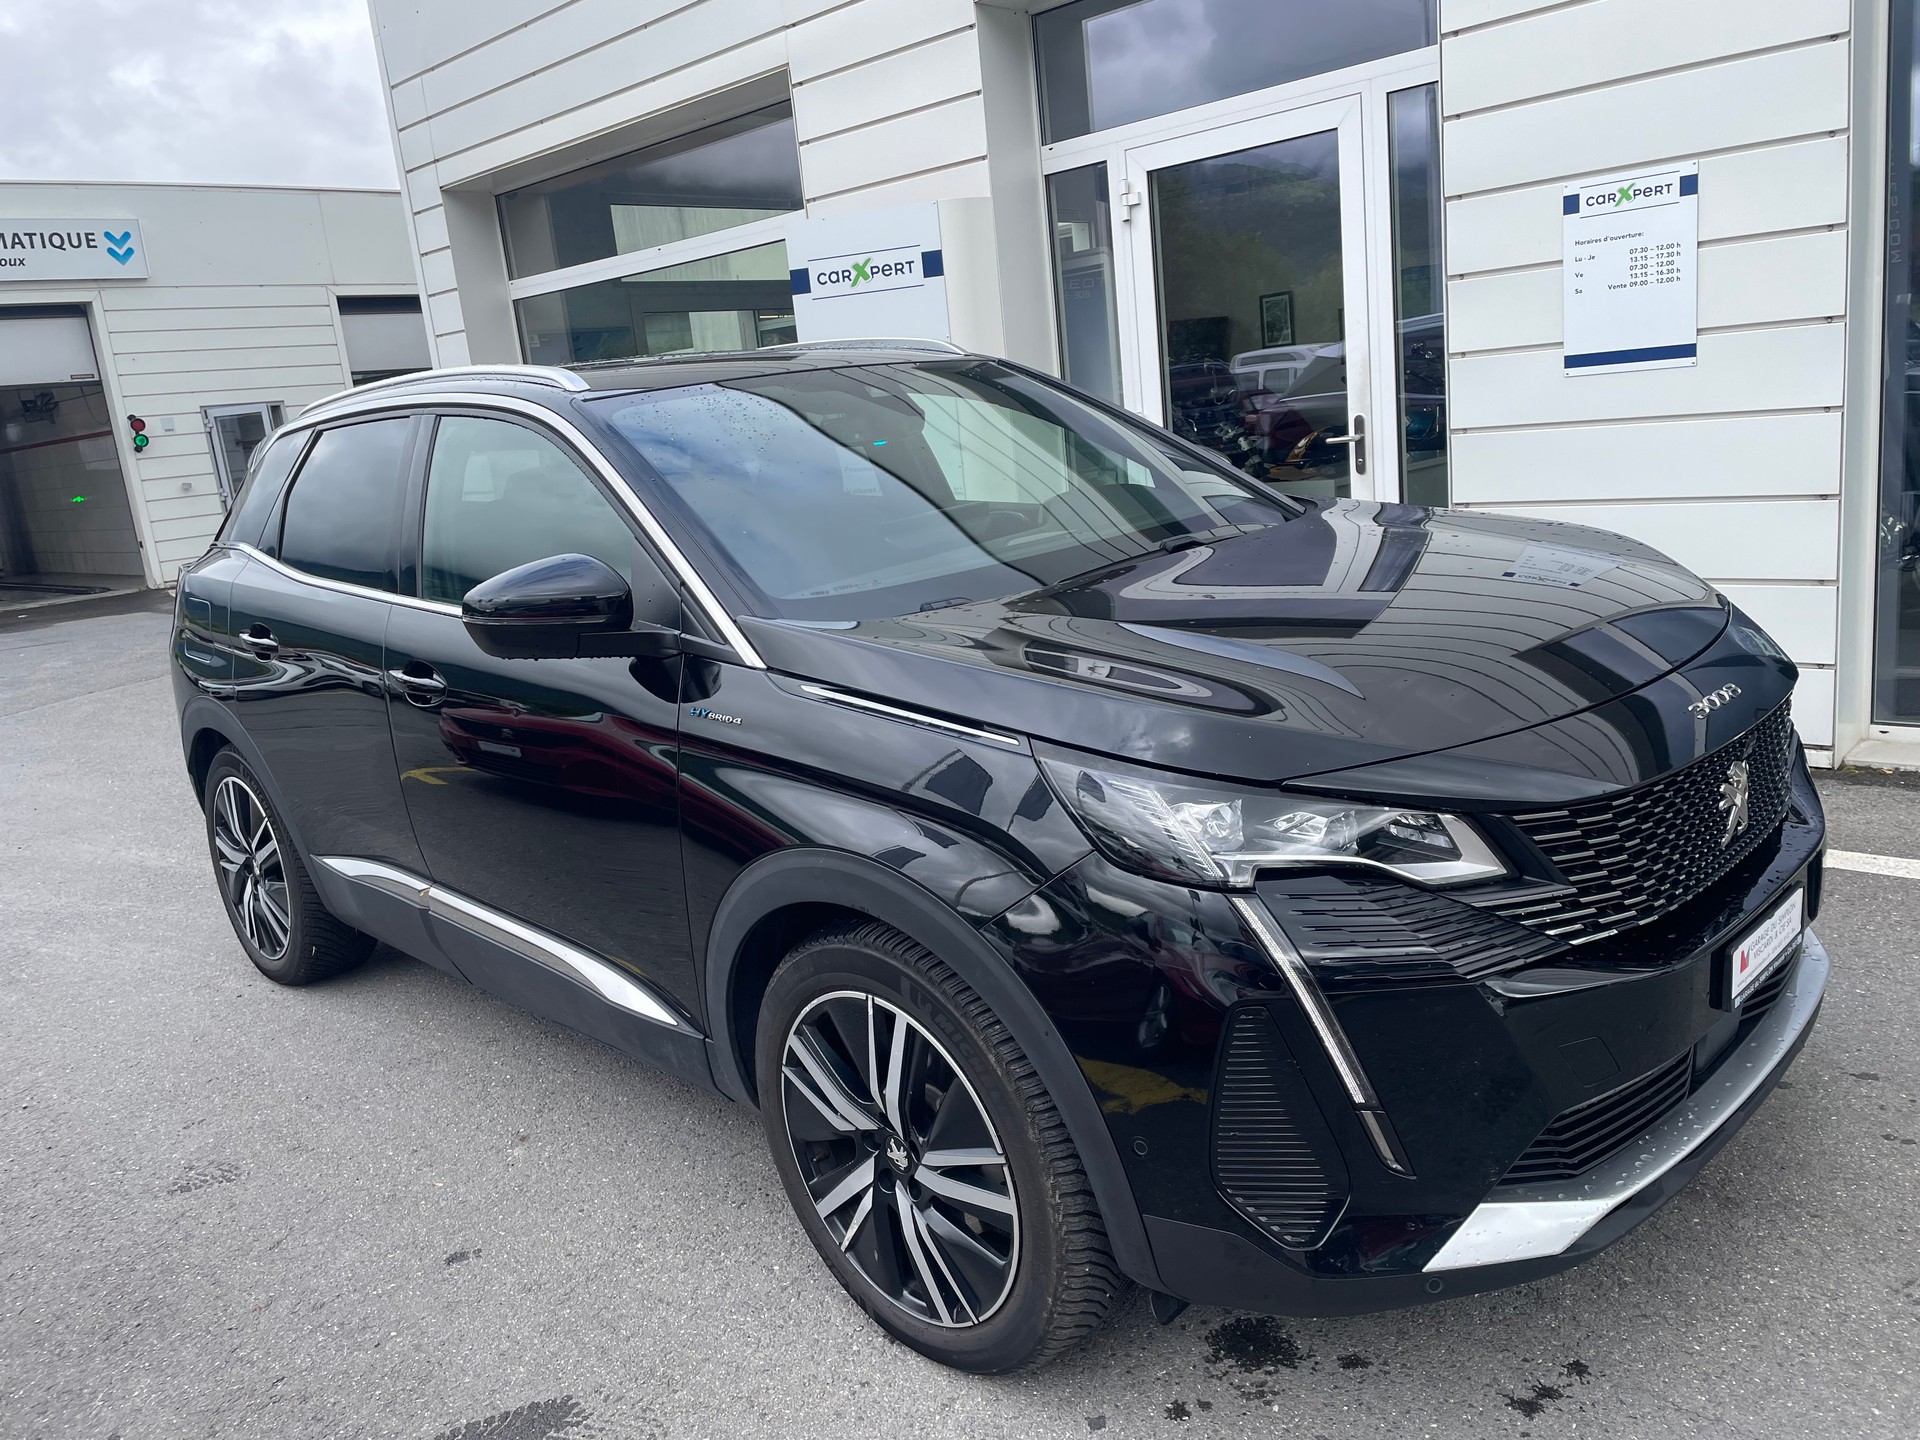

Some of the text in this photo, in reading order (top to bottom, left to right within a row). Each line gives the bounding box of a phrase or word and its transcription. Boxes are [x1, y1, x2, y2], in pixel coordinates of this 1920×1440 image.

[1574, 231, 1645, 247] Horaires d'ouverture:
[1629, 246, 1649, 255] 07.30
[1656, 242, 1675, 251] 12.00
[1629, 254, 1649, 263] 13.15
[1656, 251, 1675, 260] 17.30
[1629, 263, 1649, 272] 07.30
[1656, 259, 1675, 268] 12.00
[1629, 271, 1649, 280] 13.15
[1656, 267, 1675, 276] 16.30
[1629, 280, 1649, 288] 09.00
[1656, 276, 1675, 284] 12.00
[1687, 682, 1742, 719] 3008
[690, 706, 743, 726] HYBRID4
